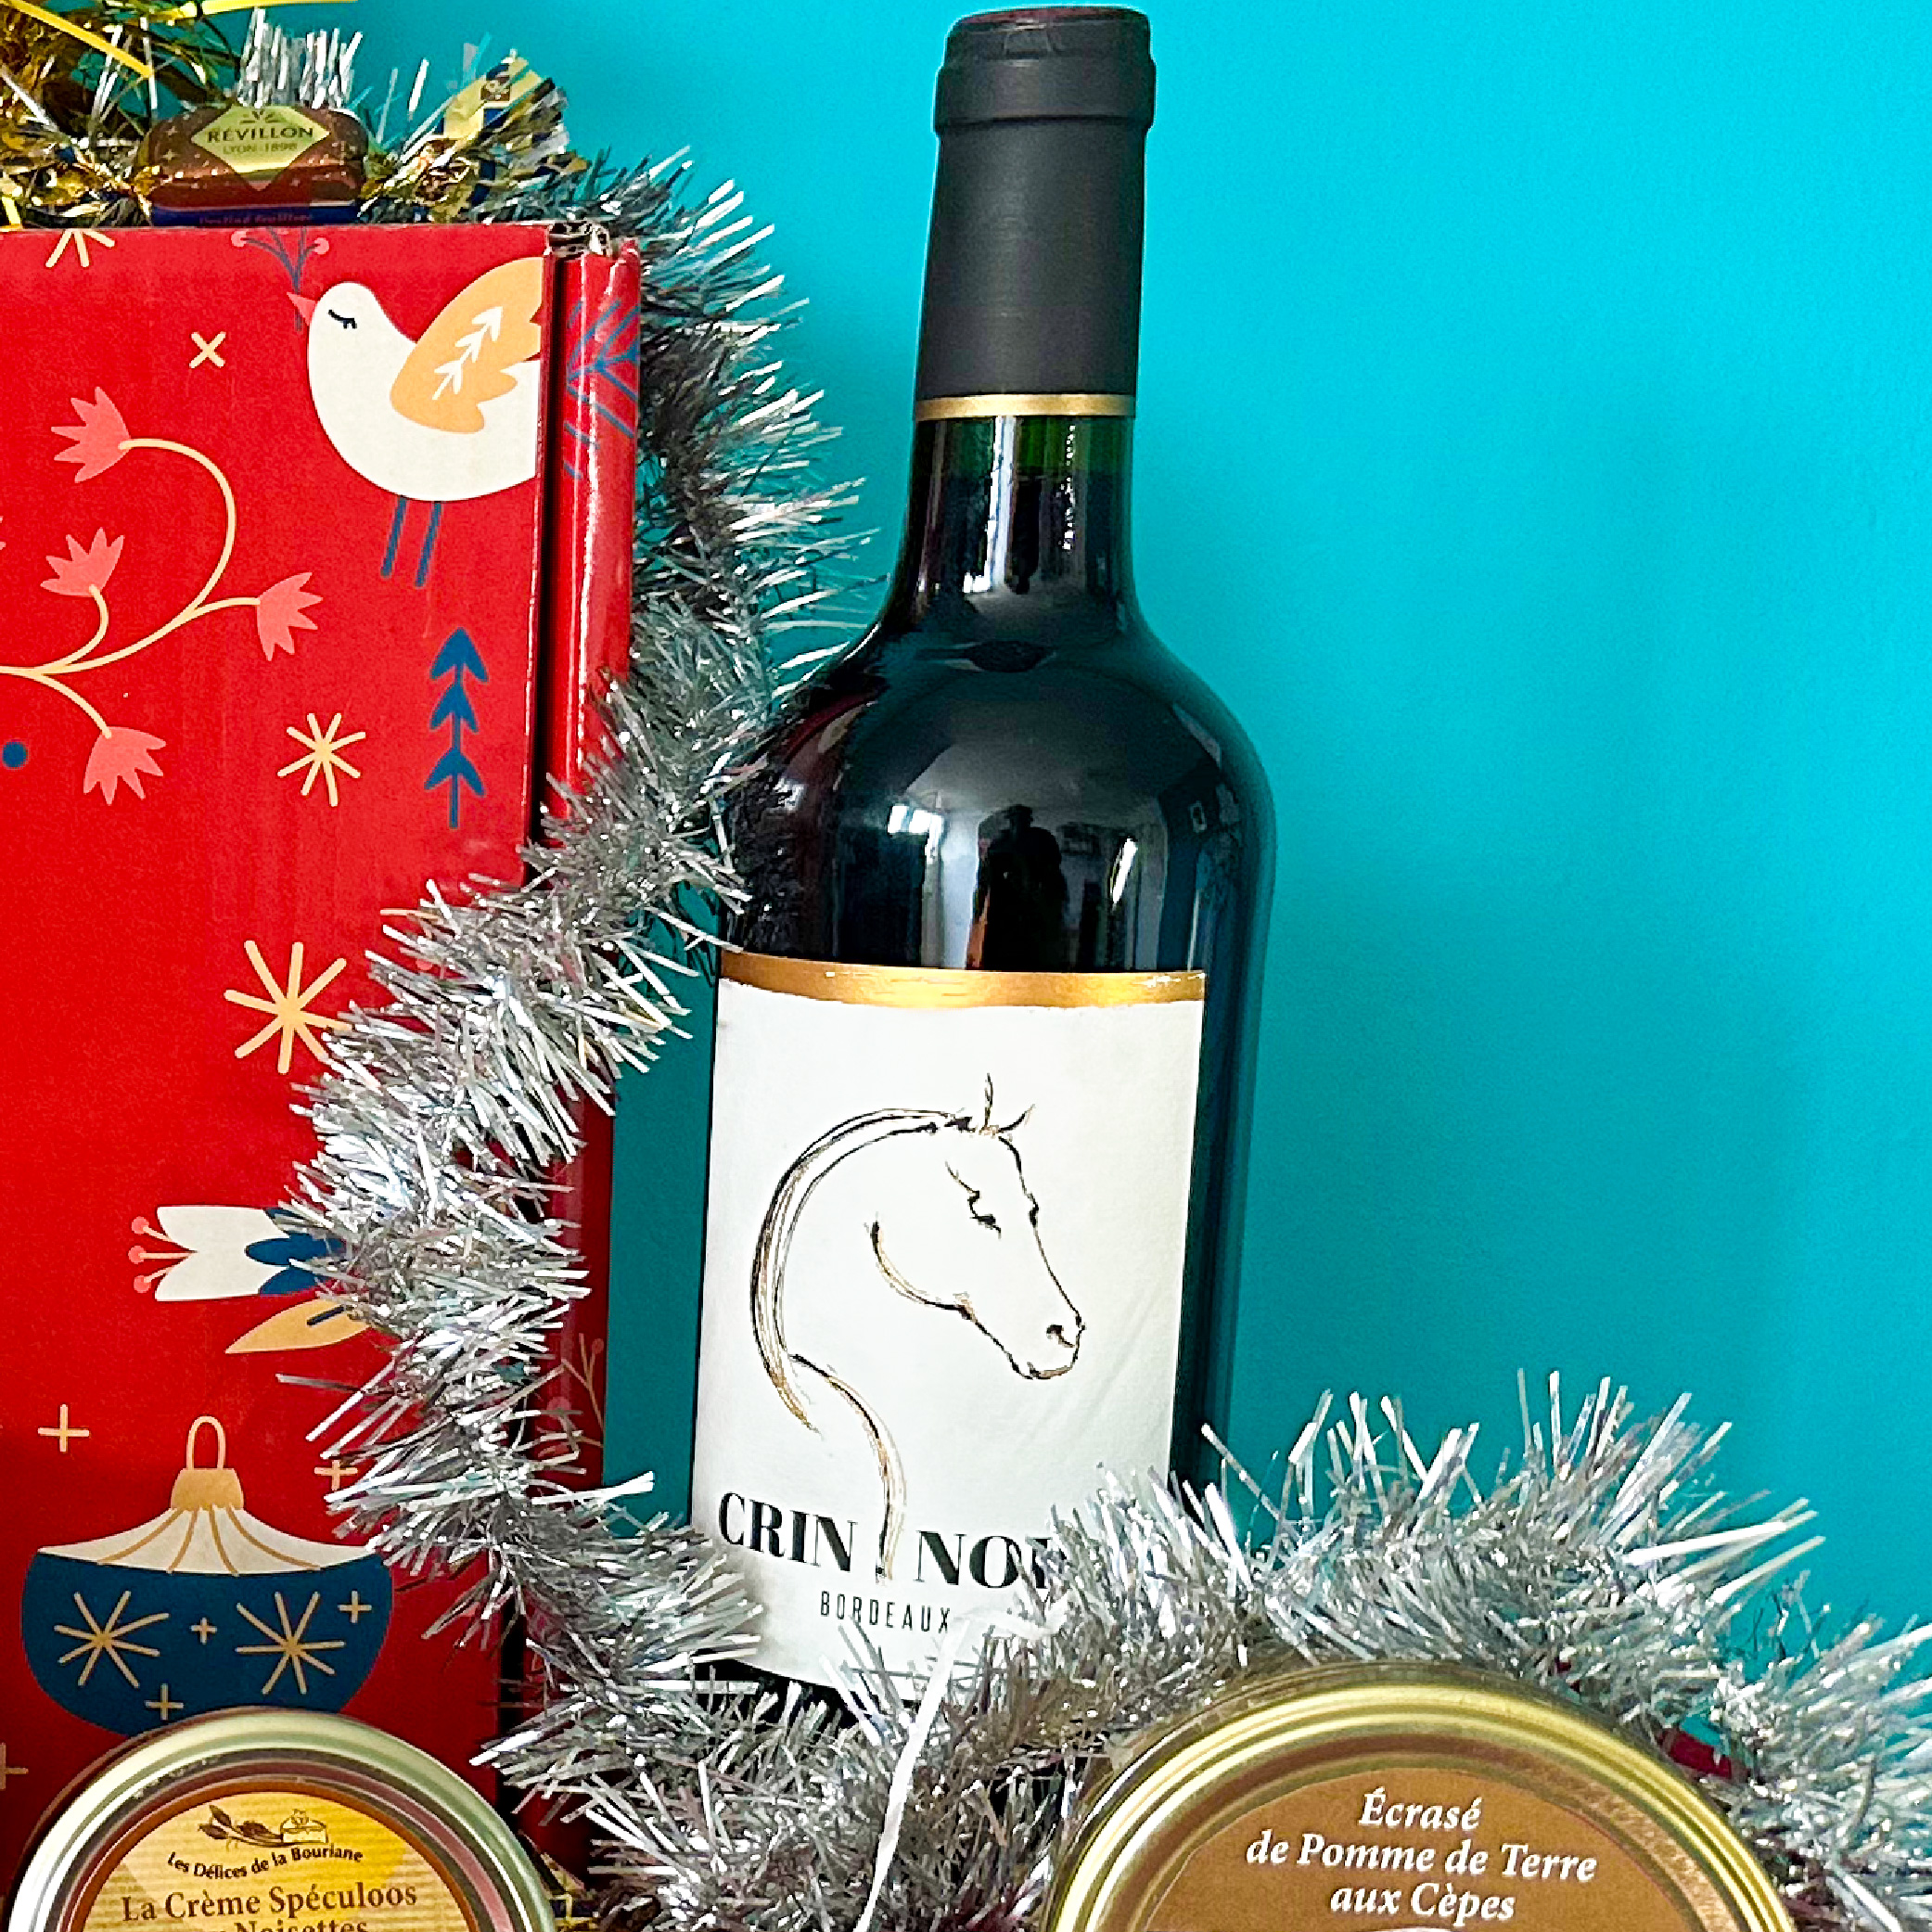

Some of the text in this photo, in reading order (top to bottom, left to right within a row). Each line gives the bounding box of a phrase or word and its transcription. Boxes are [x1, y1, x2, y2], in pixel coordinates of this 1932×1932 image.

[207, 127, 313, 143] RÉVILLON
[718, 1491, 858, 1572] CRIN
[821, 1590, 950, 1633] BORDEAUX
[1359, 1785, 1483, 1831] Écrasé
[168, 1843, 364, 1880] Les Délices de la Bouriane
[1246, 1828, 1597, 1883] de Pomme de Terre
[121, 1881, 417, 1921] La Crème Spéculoos
[1329, 1882, 1516, 1927] aux Cèpes
